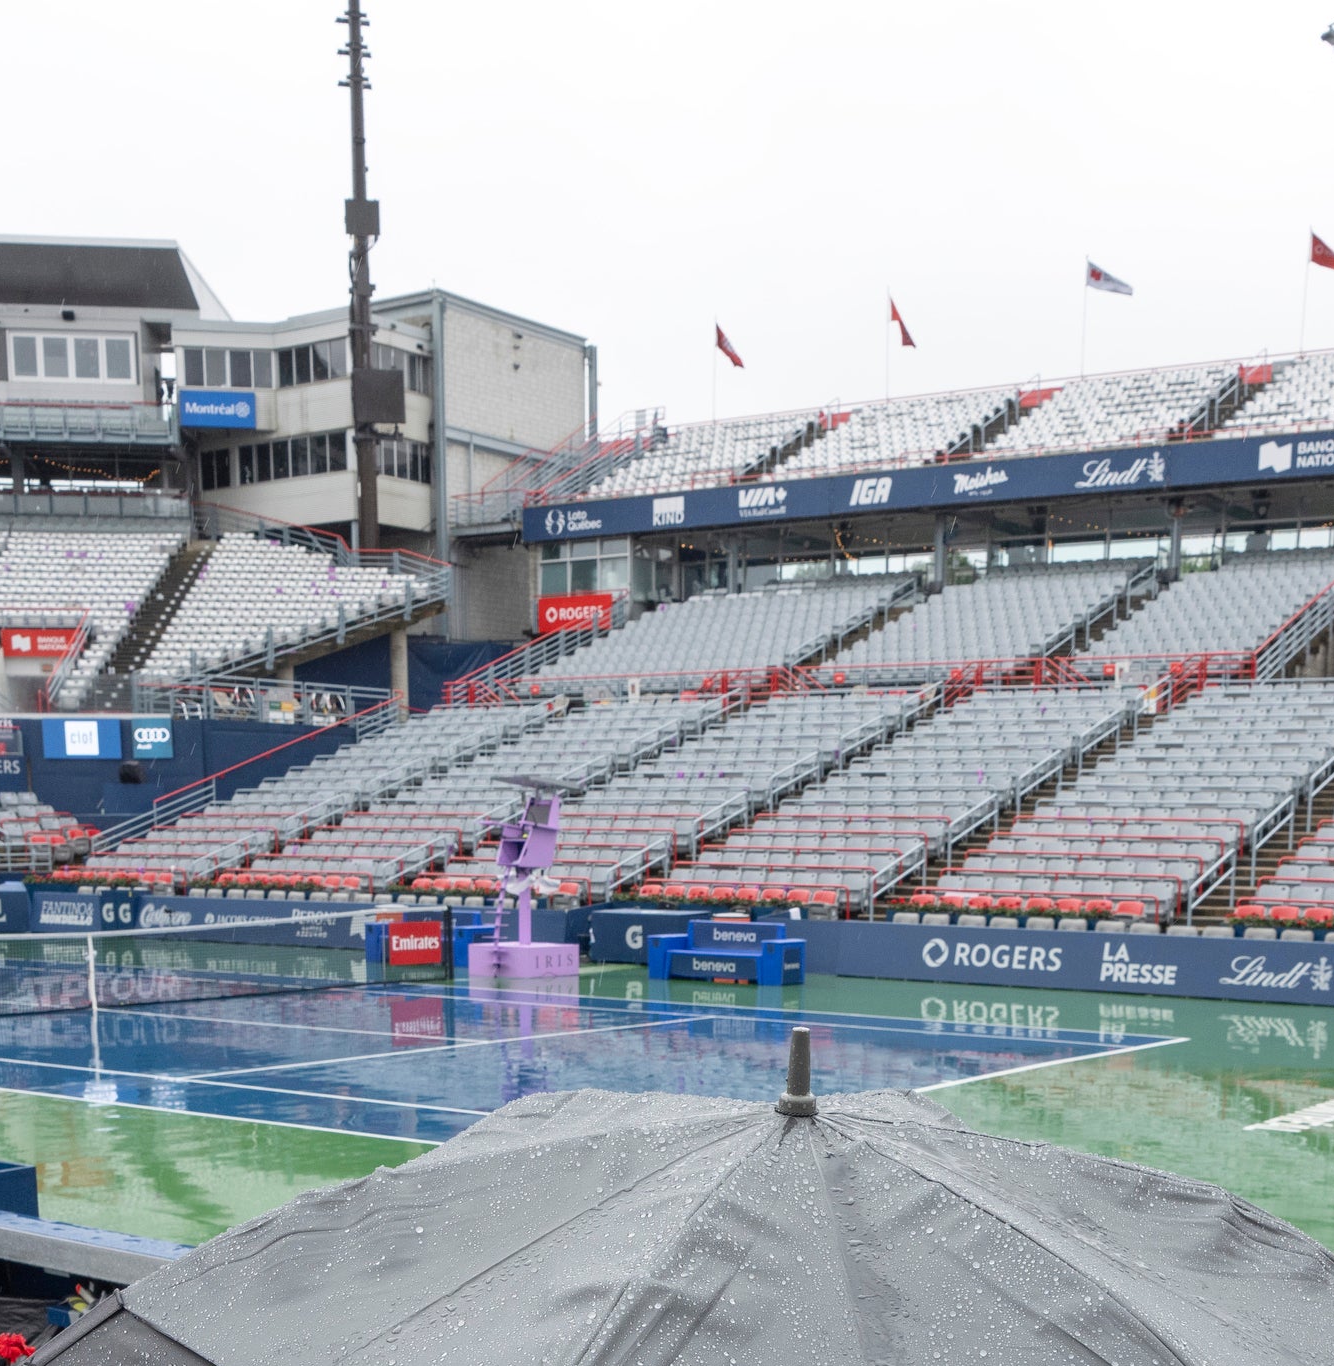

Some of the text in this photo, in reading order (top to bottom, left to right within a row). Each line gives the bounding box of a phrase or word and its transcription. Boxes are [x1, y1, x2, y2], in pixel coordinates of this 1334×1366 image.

[184, 401, 235, 416] Montréal
[953, 466, 1009, 494] Moishes
[1074, 458, 1149, 489] Lindt
[738, 486, 776, 508] VIA
[849, 477, 893, 507] IGA
[567, 510, 588, 521] Loto
[567, 518, 603, 532] Québec
[652, 510, 685, 527] KIND
[558, 605, 605, 621] ROGERS
[101, 902, 115, 923] G
[119, 902, 132, 923] G
[391, 933, 440, 952] Emirates
[624, 925, 644, 949] G
[712, 927, 757, 943] beneva
[534, 953, 575, 969] IRIS
[953, 942, 1064, 973] ROGERS
[1102, 941, 1130, 963] LA
[692, 957, 737, 973] beneva
[1099, 960, 1179, 986] PRESSE
[1219, 954, 1313, 990] Lindt
